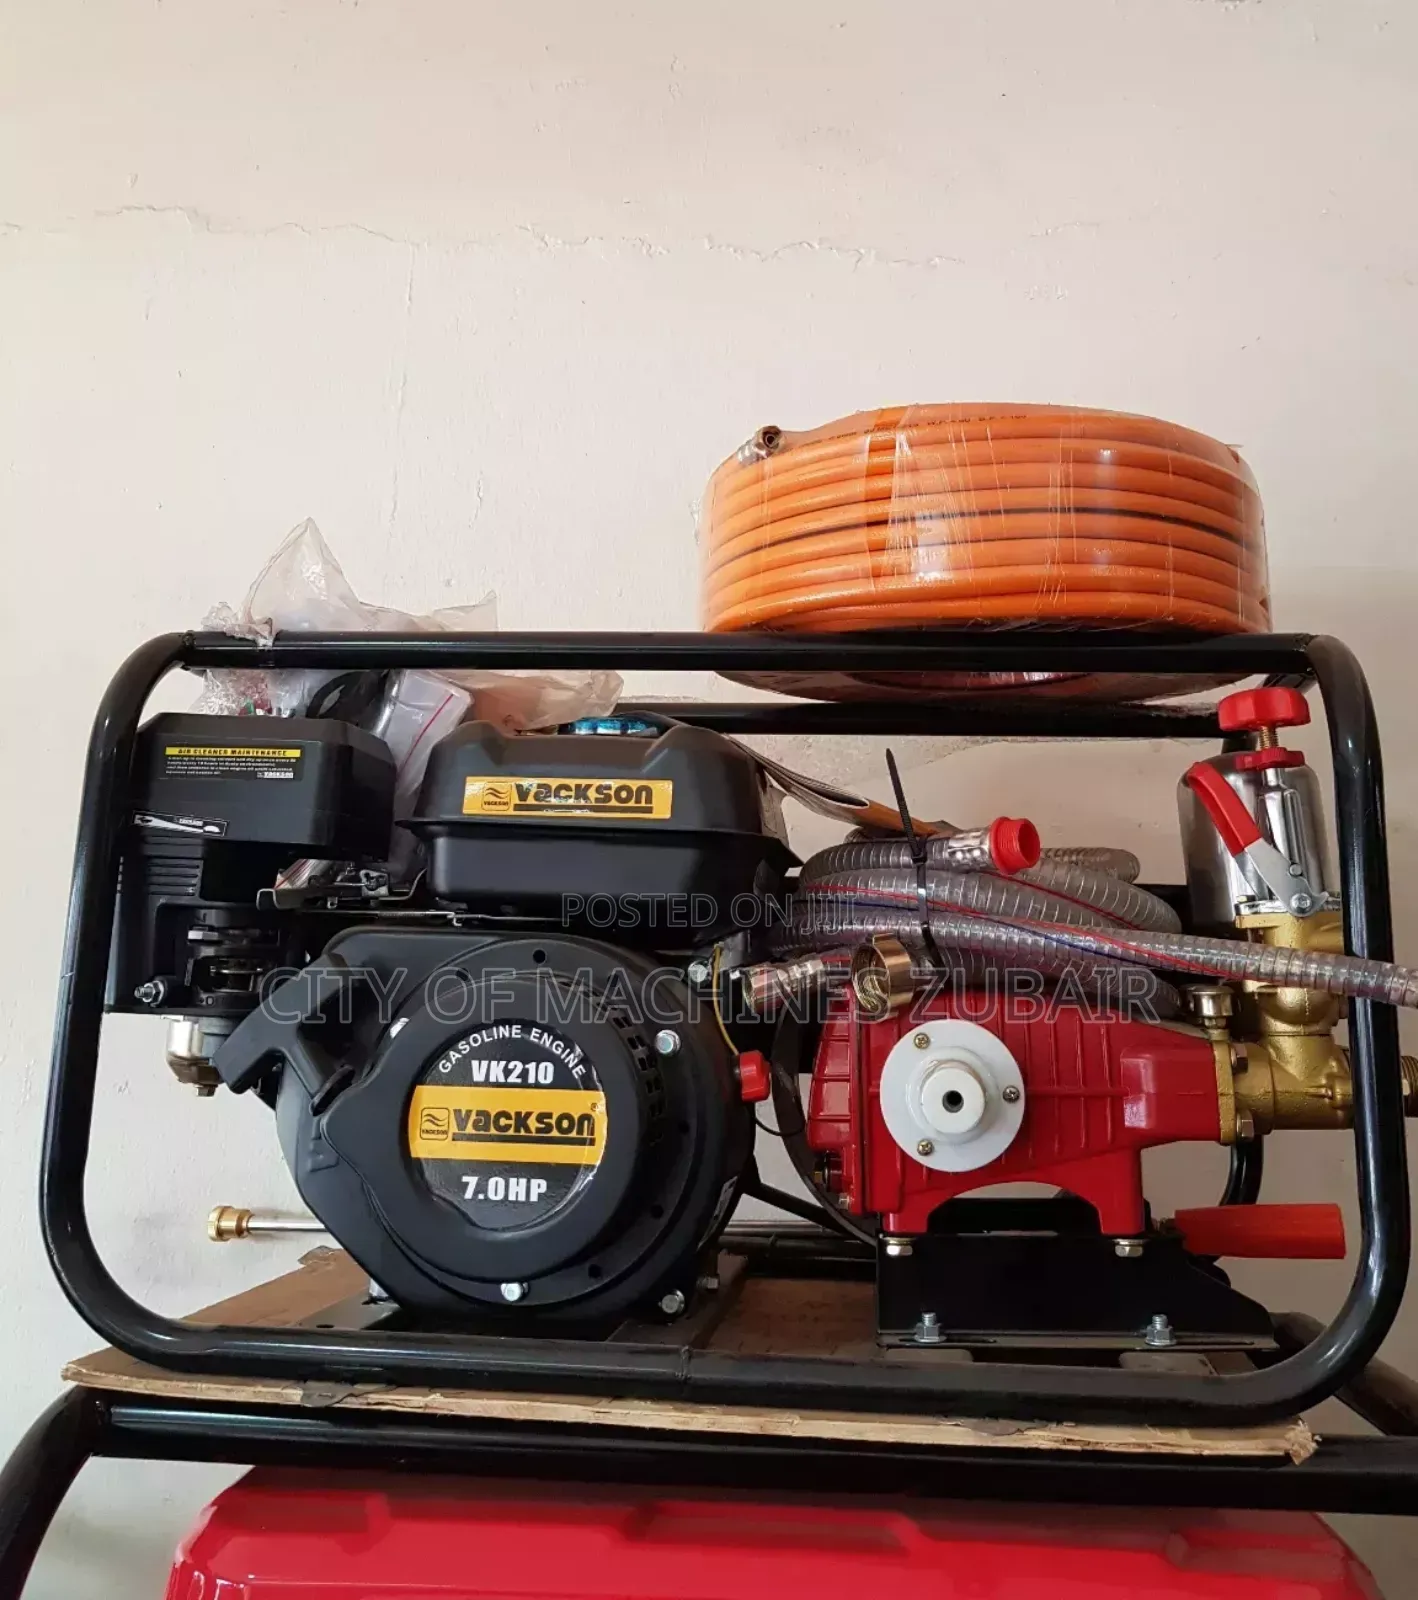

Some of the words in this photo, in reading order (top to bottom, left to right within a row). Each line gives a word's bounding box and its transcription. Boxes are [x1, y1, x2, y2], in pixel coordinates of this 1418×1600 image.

[438, 1025, 522, 1074] GASOLINE
[529, 1027, 587, 1080] ENGINE
[471, 1060, 555, 1084] VK210
[461, 1175, 548, 1202] 7.0HP
